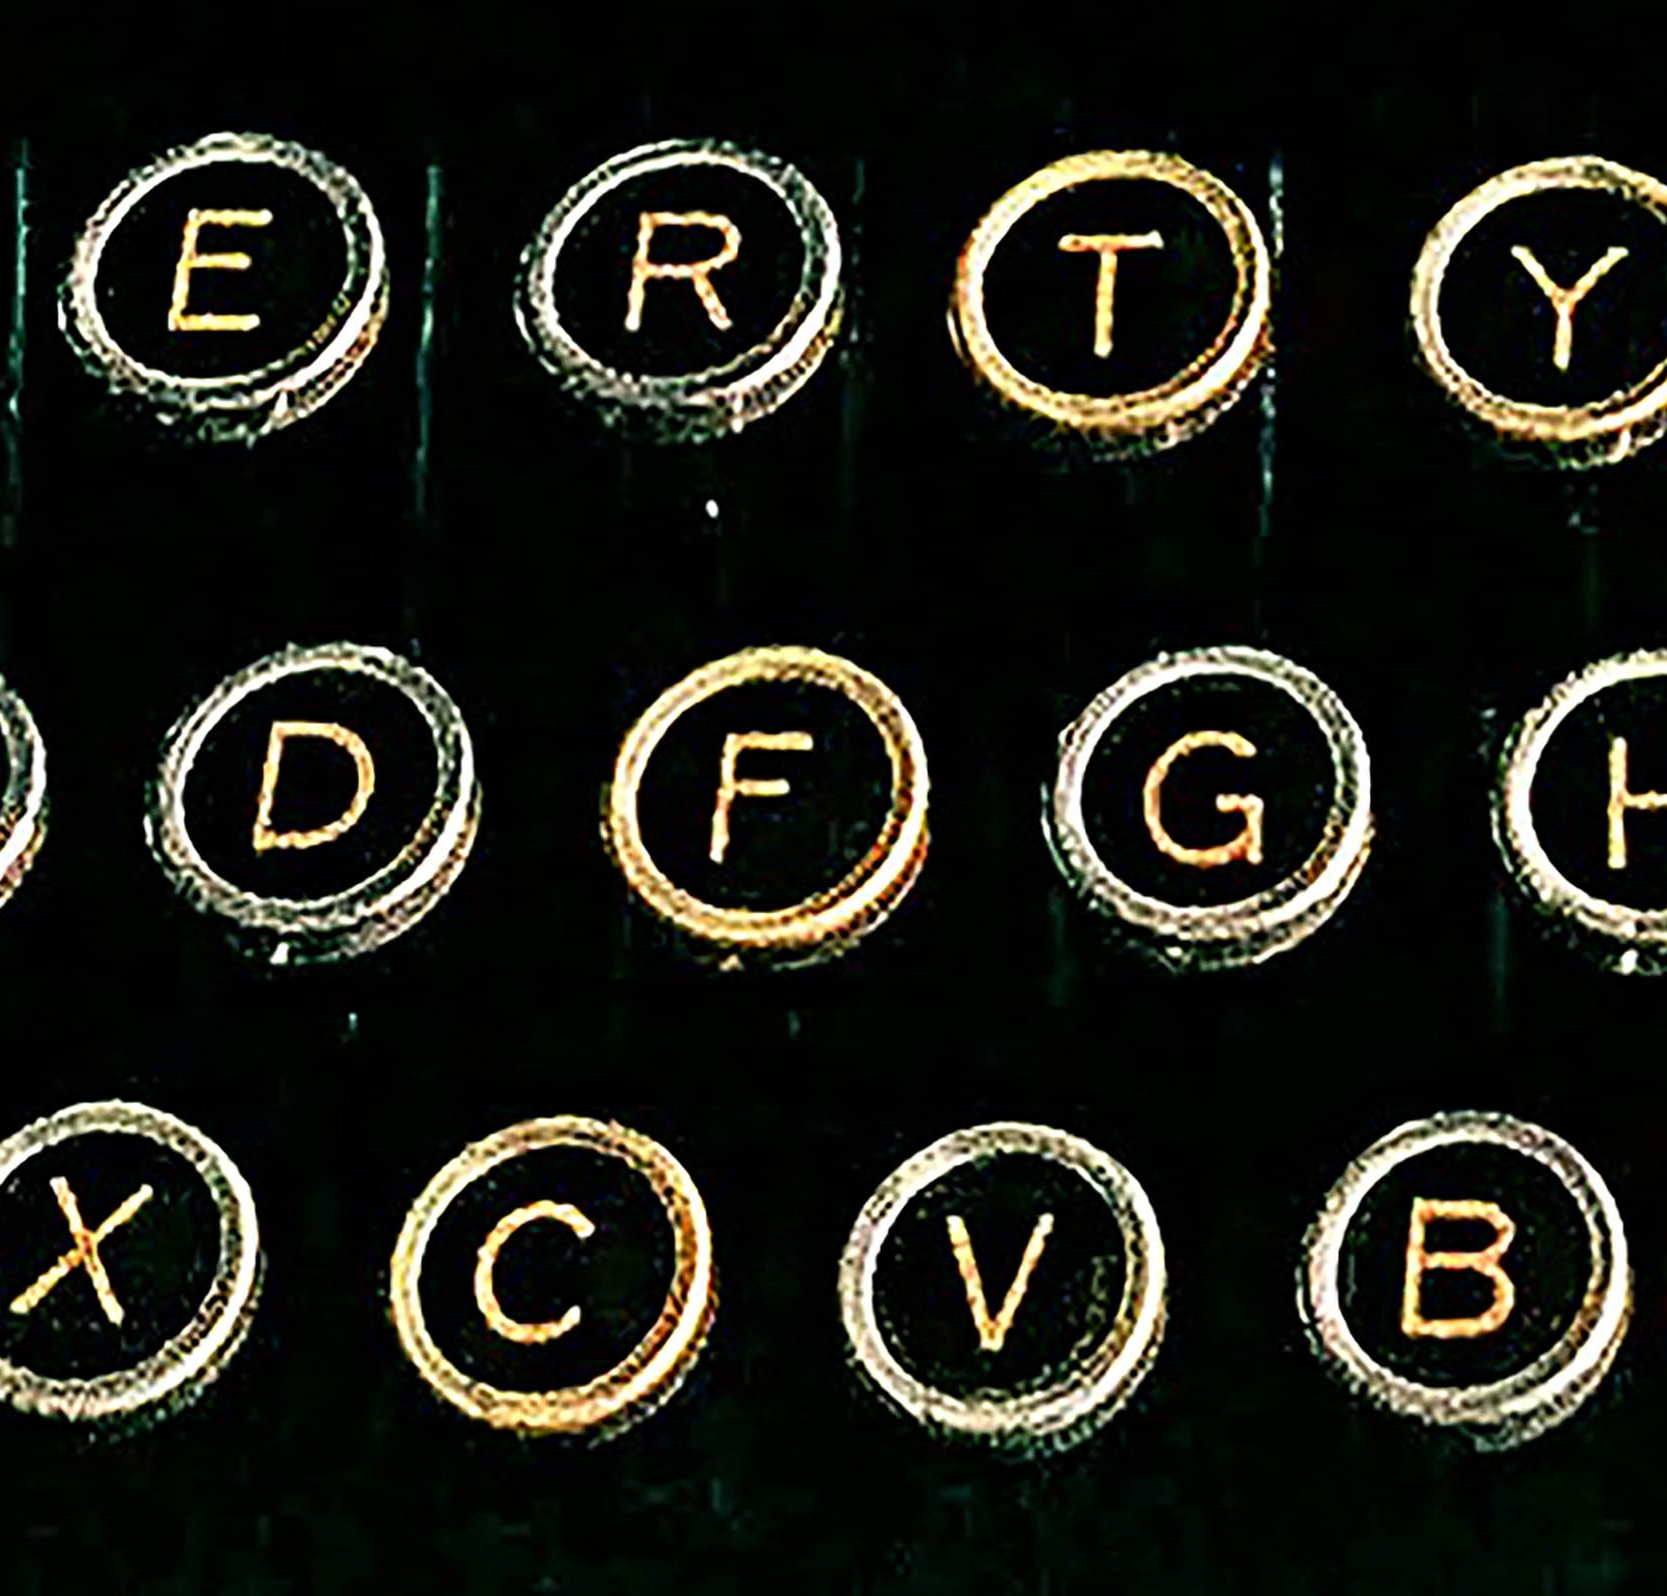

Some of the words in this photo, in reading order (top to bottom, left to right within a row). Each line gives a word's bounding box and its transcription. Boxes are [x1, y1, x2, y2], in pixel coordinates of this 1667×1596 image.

[168, 208, 273, 331] E
[625, 211, 735, 331] R
[1058, 230, 1164, 357] T
[1511, 246, 1628, 370] Y
[253, 721, 375, 851] D
[710, 731, 813, 863] F
[1143, 731, 1264, 868] G
[10, 1177, 153, 1326] X
[474, 1200, 595, 1343] C
[947, 1213, 1054, 1351] V
[1401, 1197, 1515, 1339] B
